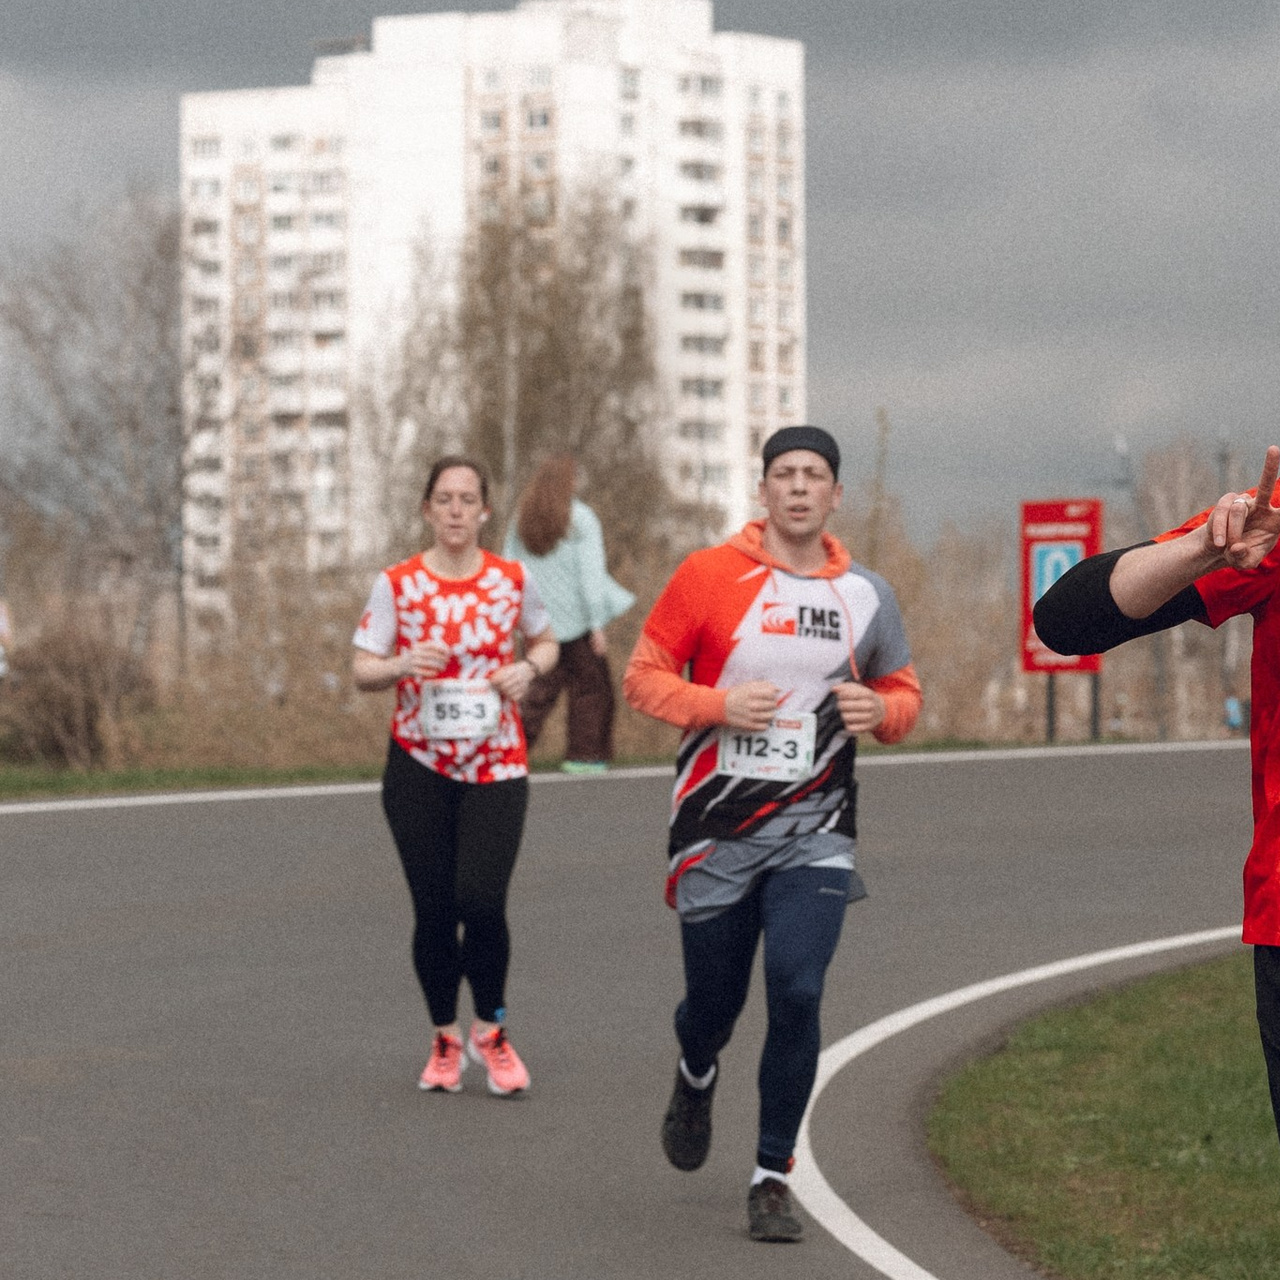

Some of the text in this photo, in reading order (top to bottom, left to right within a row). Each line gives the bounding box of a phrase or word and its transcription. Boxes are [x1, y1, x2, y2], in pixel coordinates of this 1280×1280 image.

[798, 606, 840, 628] ГМС
[435, 703, 486, 720] 55-3
[734, 735, 798, 759] 112-3
